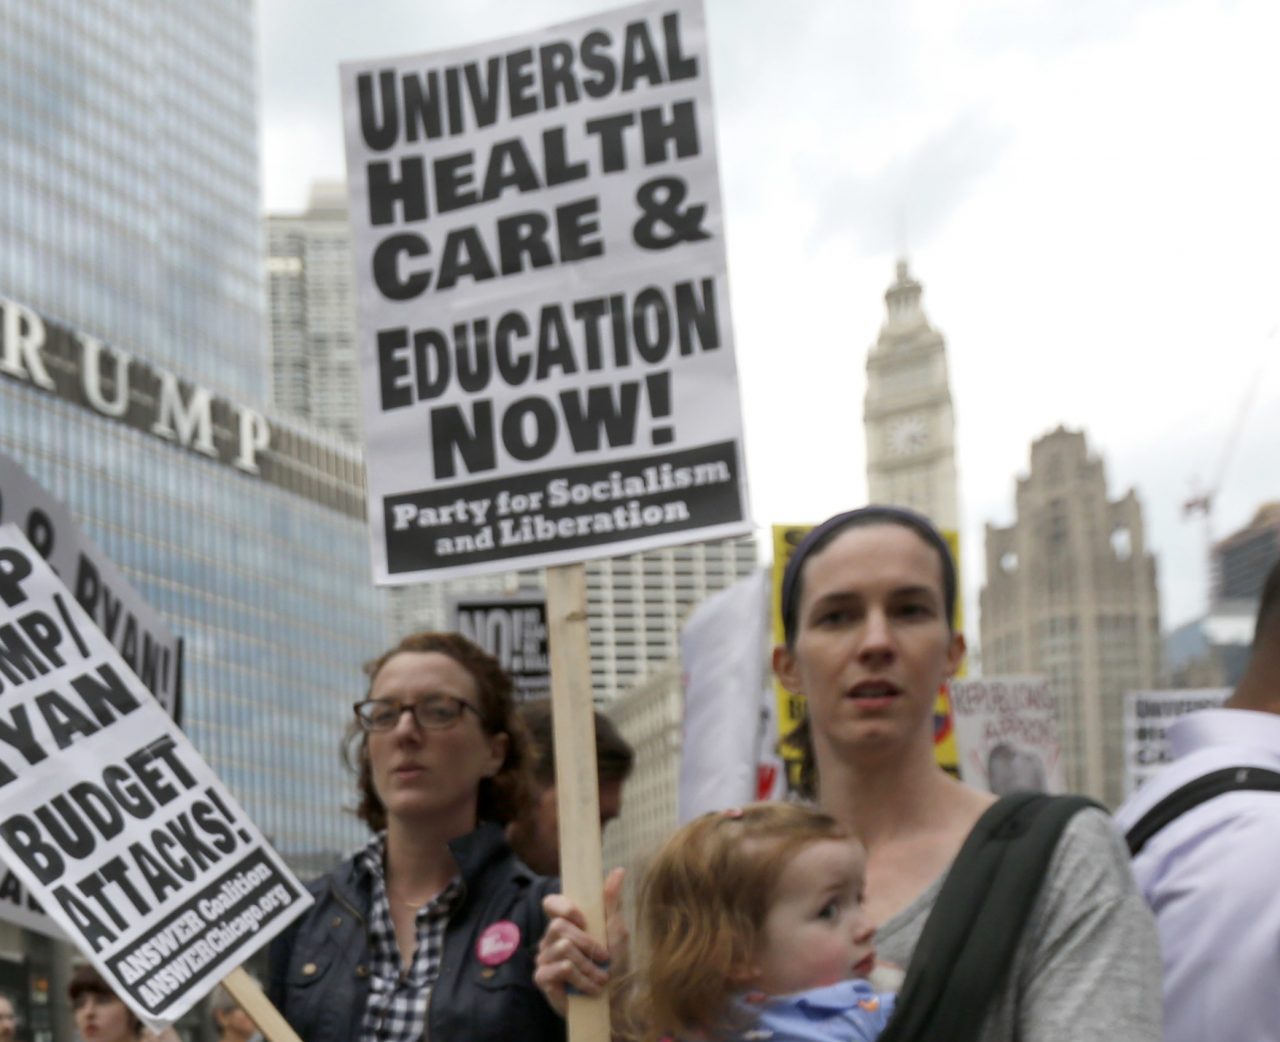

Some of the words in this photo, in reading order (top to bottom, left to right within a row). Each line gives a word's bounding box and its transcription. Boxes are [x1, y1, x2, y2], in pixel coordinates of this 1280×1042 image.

[356, 10, 700, 151] UNIVERSAL
[365, 98, 701, 227] HEALTH
[371, 196, 605, 302] CARE
[632, 175, 713, 251] &
[376, 276, 722, 412] EDUCATION
[429, 369, 675, 481] NOW!
[392, 496, 488, 531] Party
[496, 489, 542, 514] for
[546, 459, 730, 508] Socialism
[435, 528, 494, 556] and
[499, 501, 690, 547] Liberation
[51, 785, 253, 954] ATTACKS!
[116, 908, 206, 986] ANSWER
[197, 862, 273, 922] Coalition
[137, 883, 293, 1010] ANSWERChicago.org
